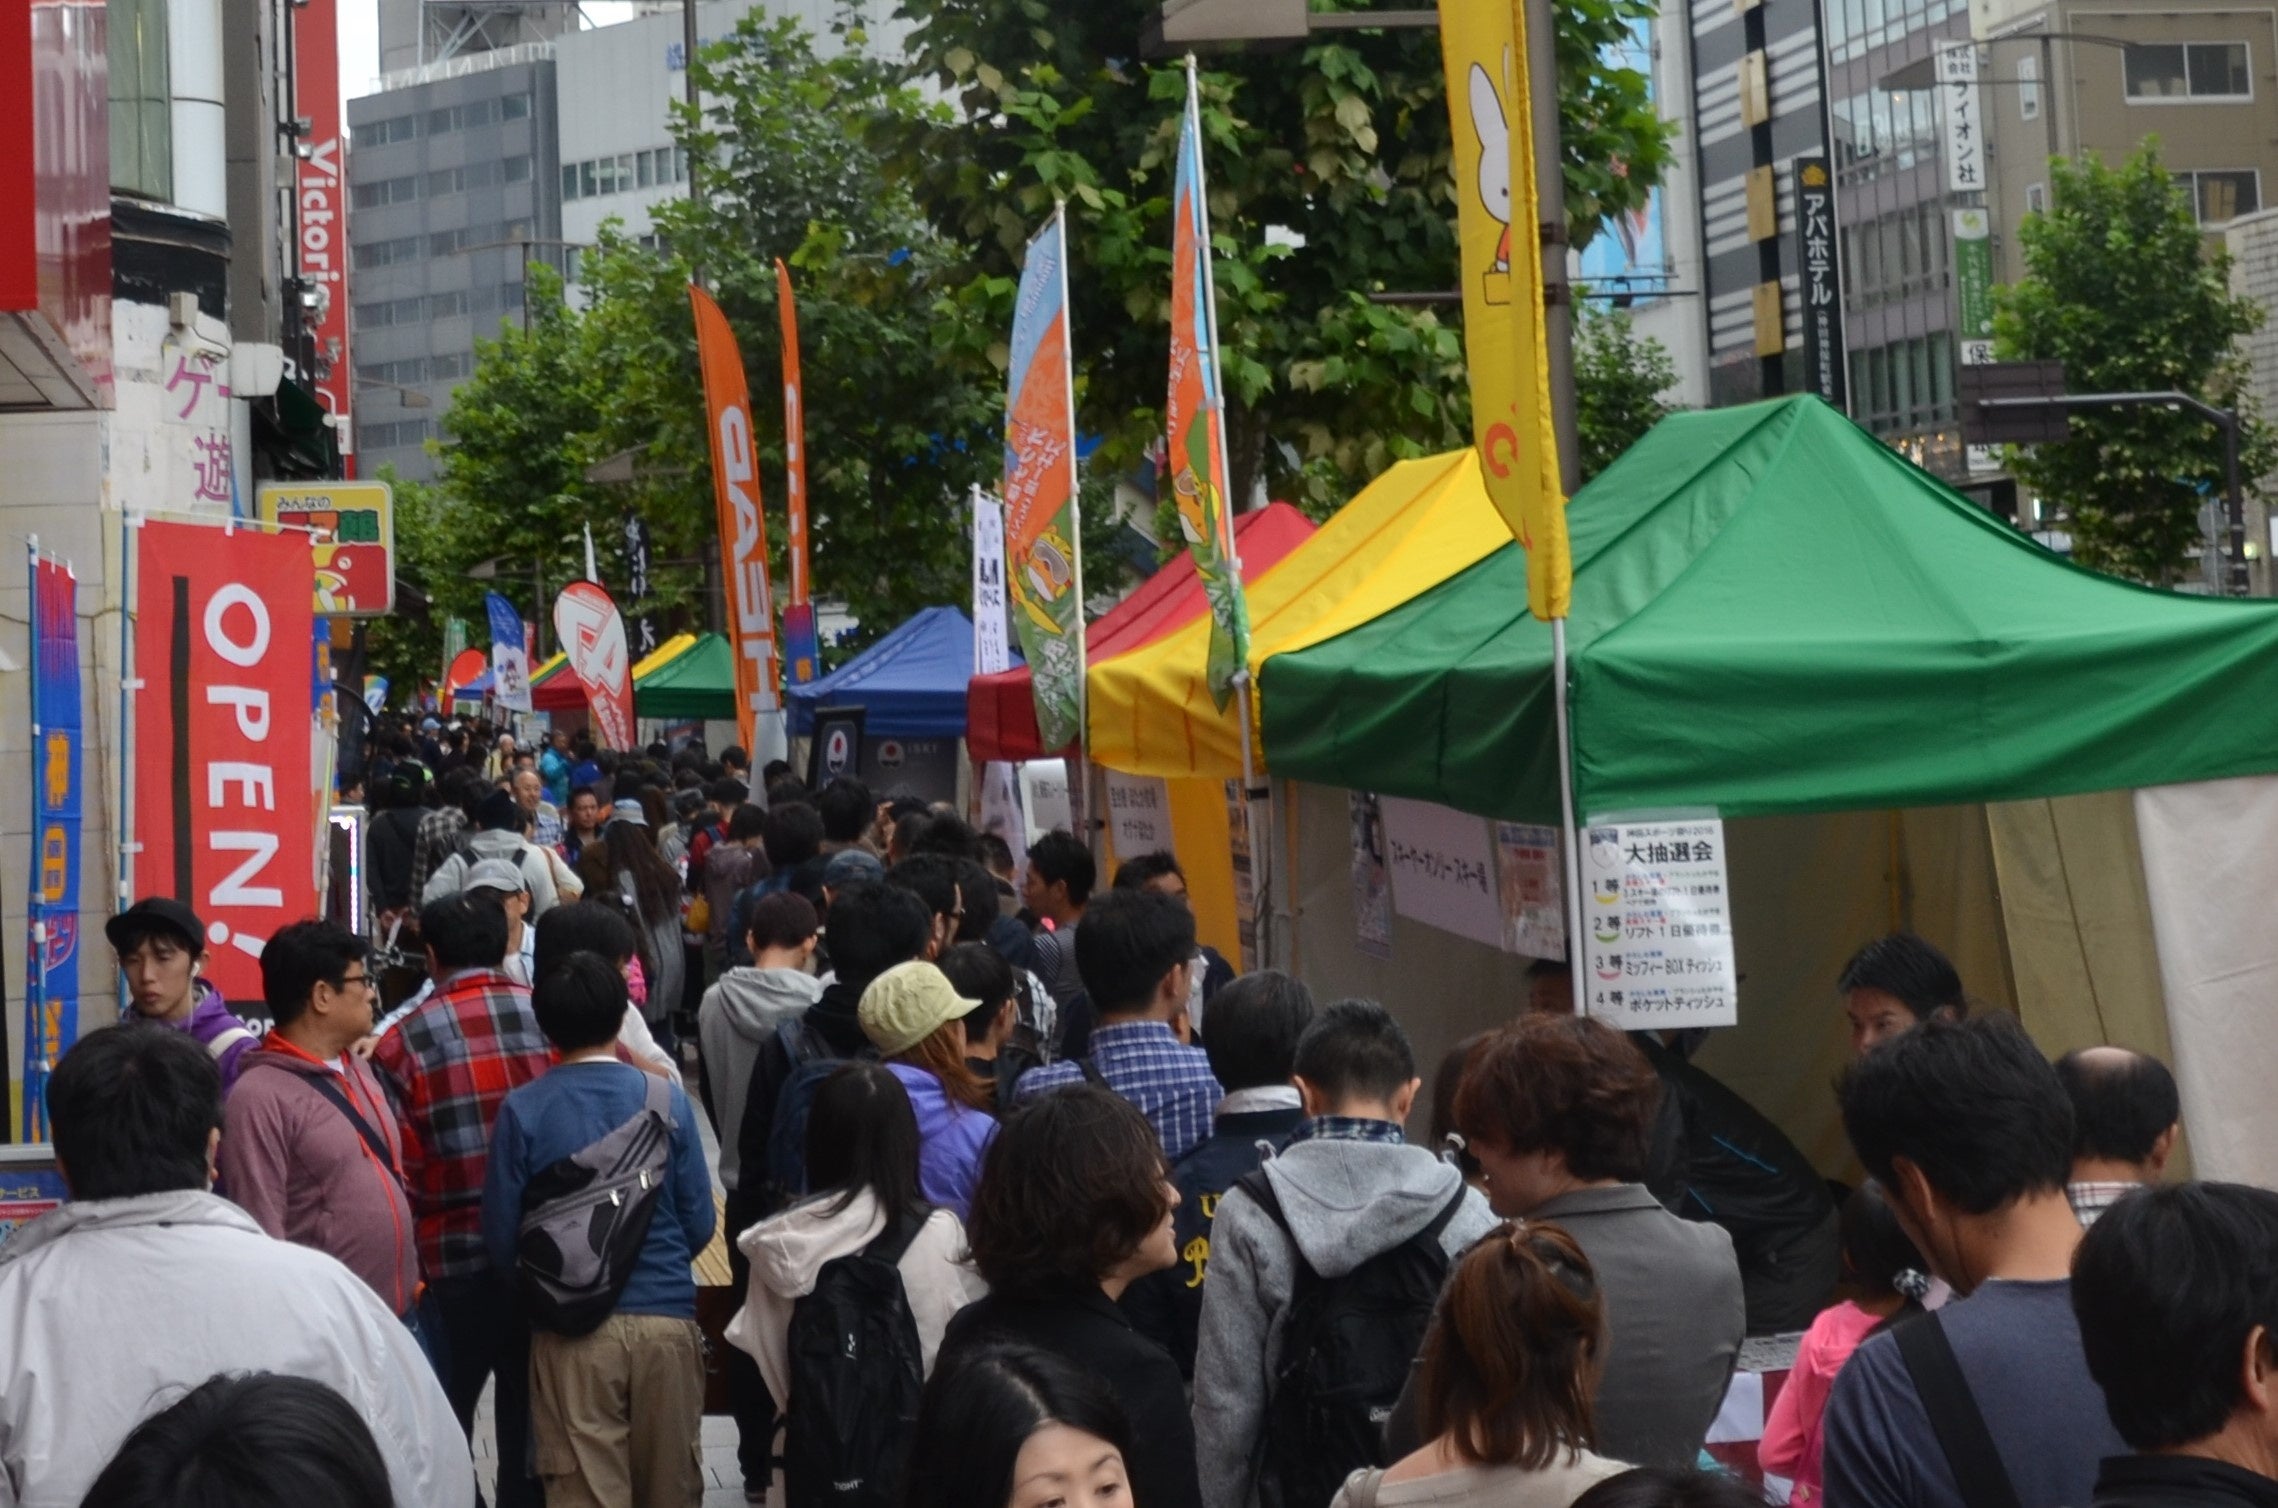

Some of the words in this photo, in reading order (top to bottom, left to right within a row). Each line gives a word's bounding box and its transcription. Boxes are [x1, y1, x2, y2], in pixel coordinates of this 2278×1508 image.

[1804, 194, 1832, 306] アパホテル
[166, 355, 231, 420] ゲ
[204, 583, 284, 959] OPEN!
[1624, 840, 1713, 864] 大抽選会
[1630, 995, 1725, 1012] ポケットティッシュ
